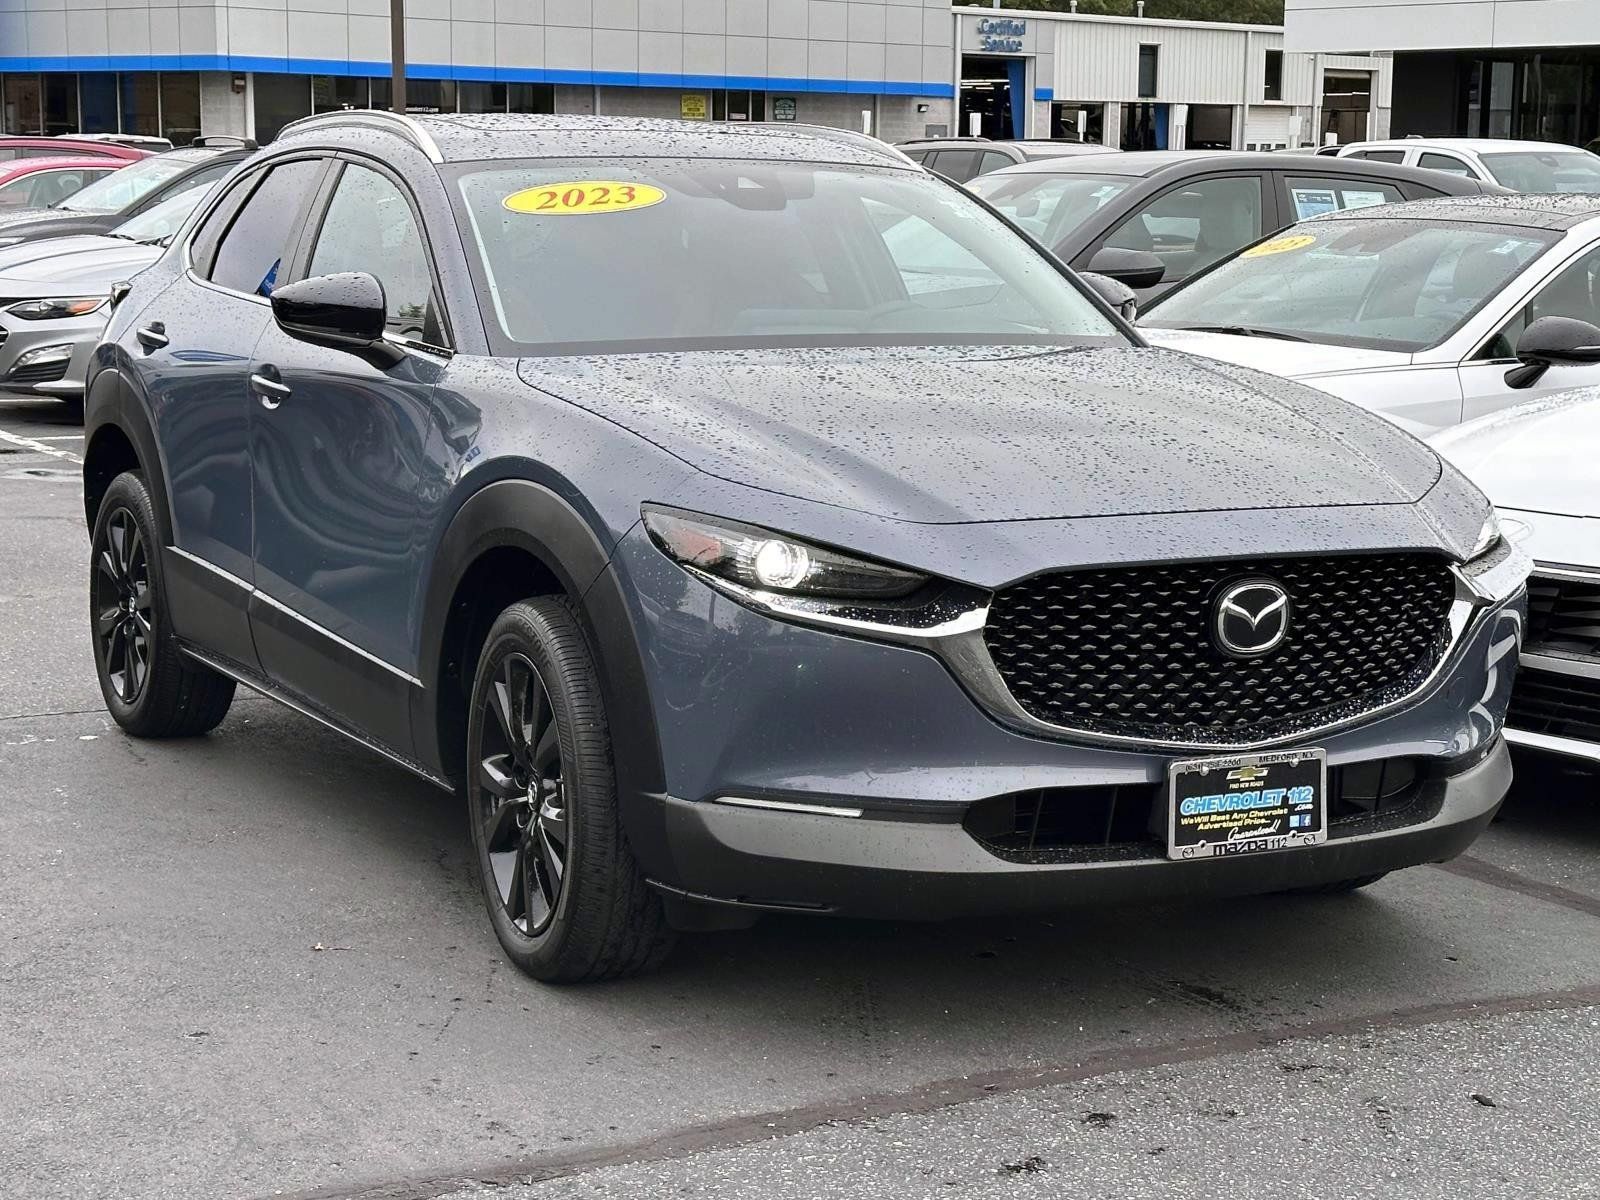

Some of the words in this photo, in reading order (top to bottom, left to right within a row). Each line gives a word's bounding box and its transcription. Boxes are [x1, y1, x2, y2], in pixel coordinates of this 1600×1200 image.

[979, 18, 1026, 36] Certified
[982, 36, 1023, 52] Service
[536, 186, 636, 210] 2023
[1180, 788, 1287, 815] CHEVROLET
[1288, 786, 1314, 805] 112
[1210, 814, 1230, 822] Beat
[1231, 812, 1248, 820] Any
[1249, 808, 1289, 818] Chevrolet
[1197, 820, 1244, 831] Advertised
[1270, 837, 1288, 849] 112
